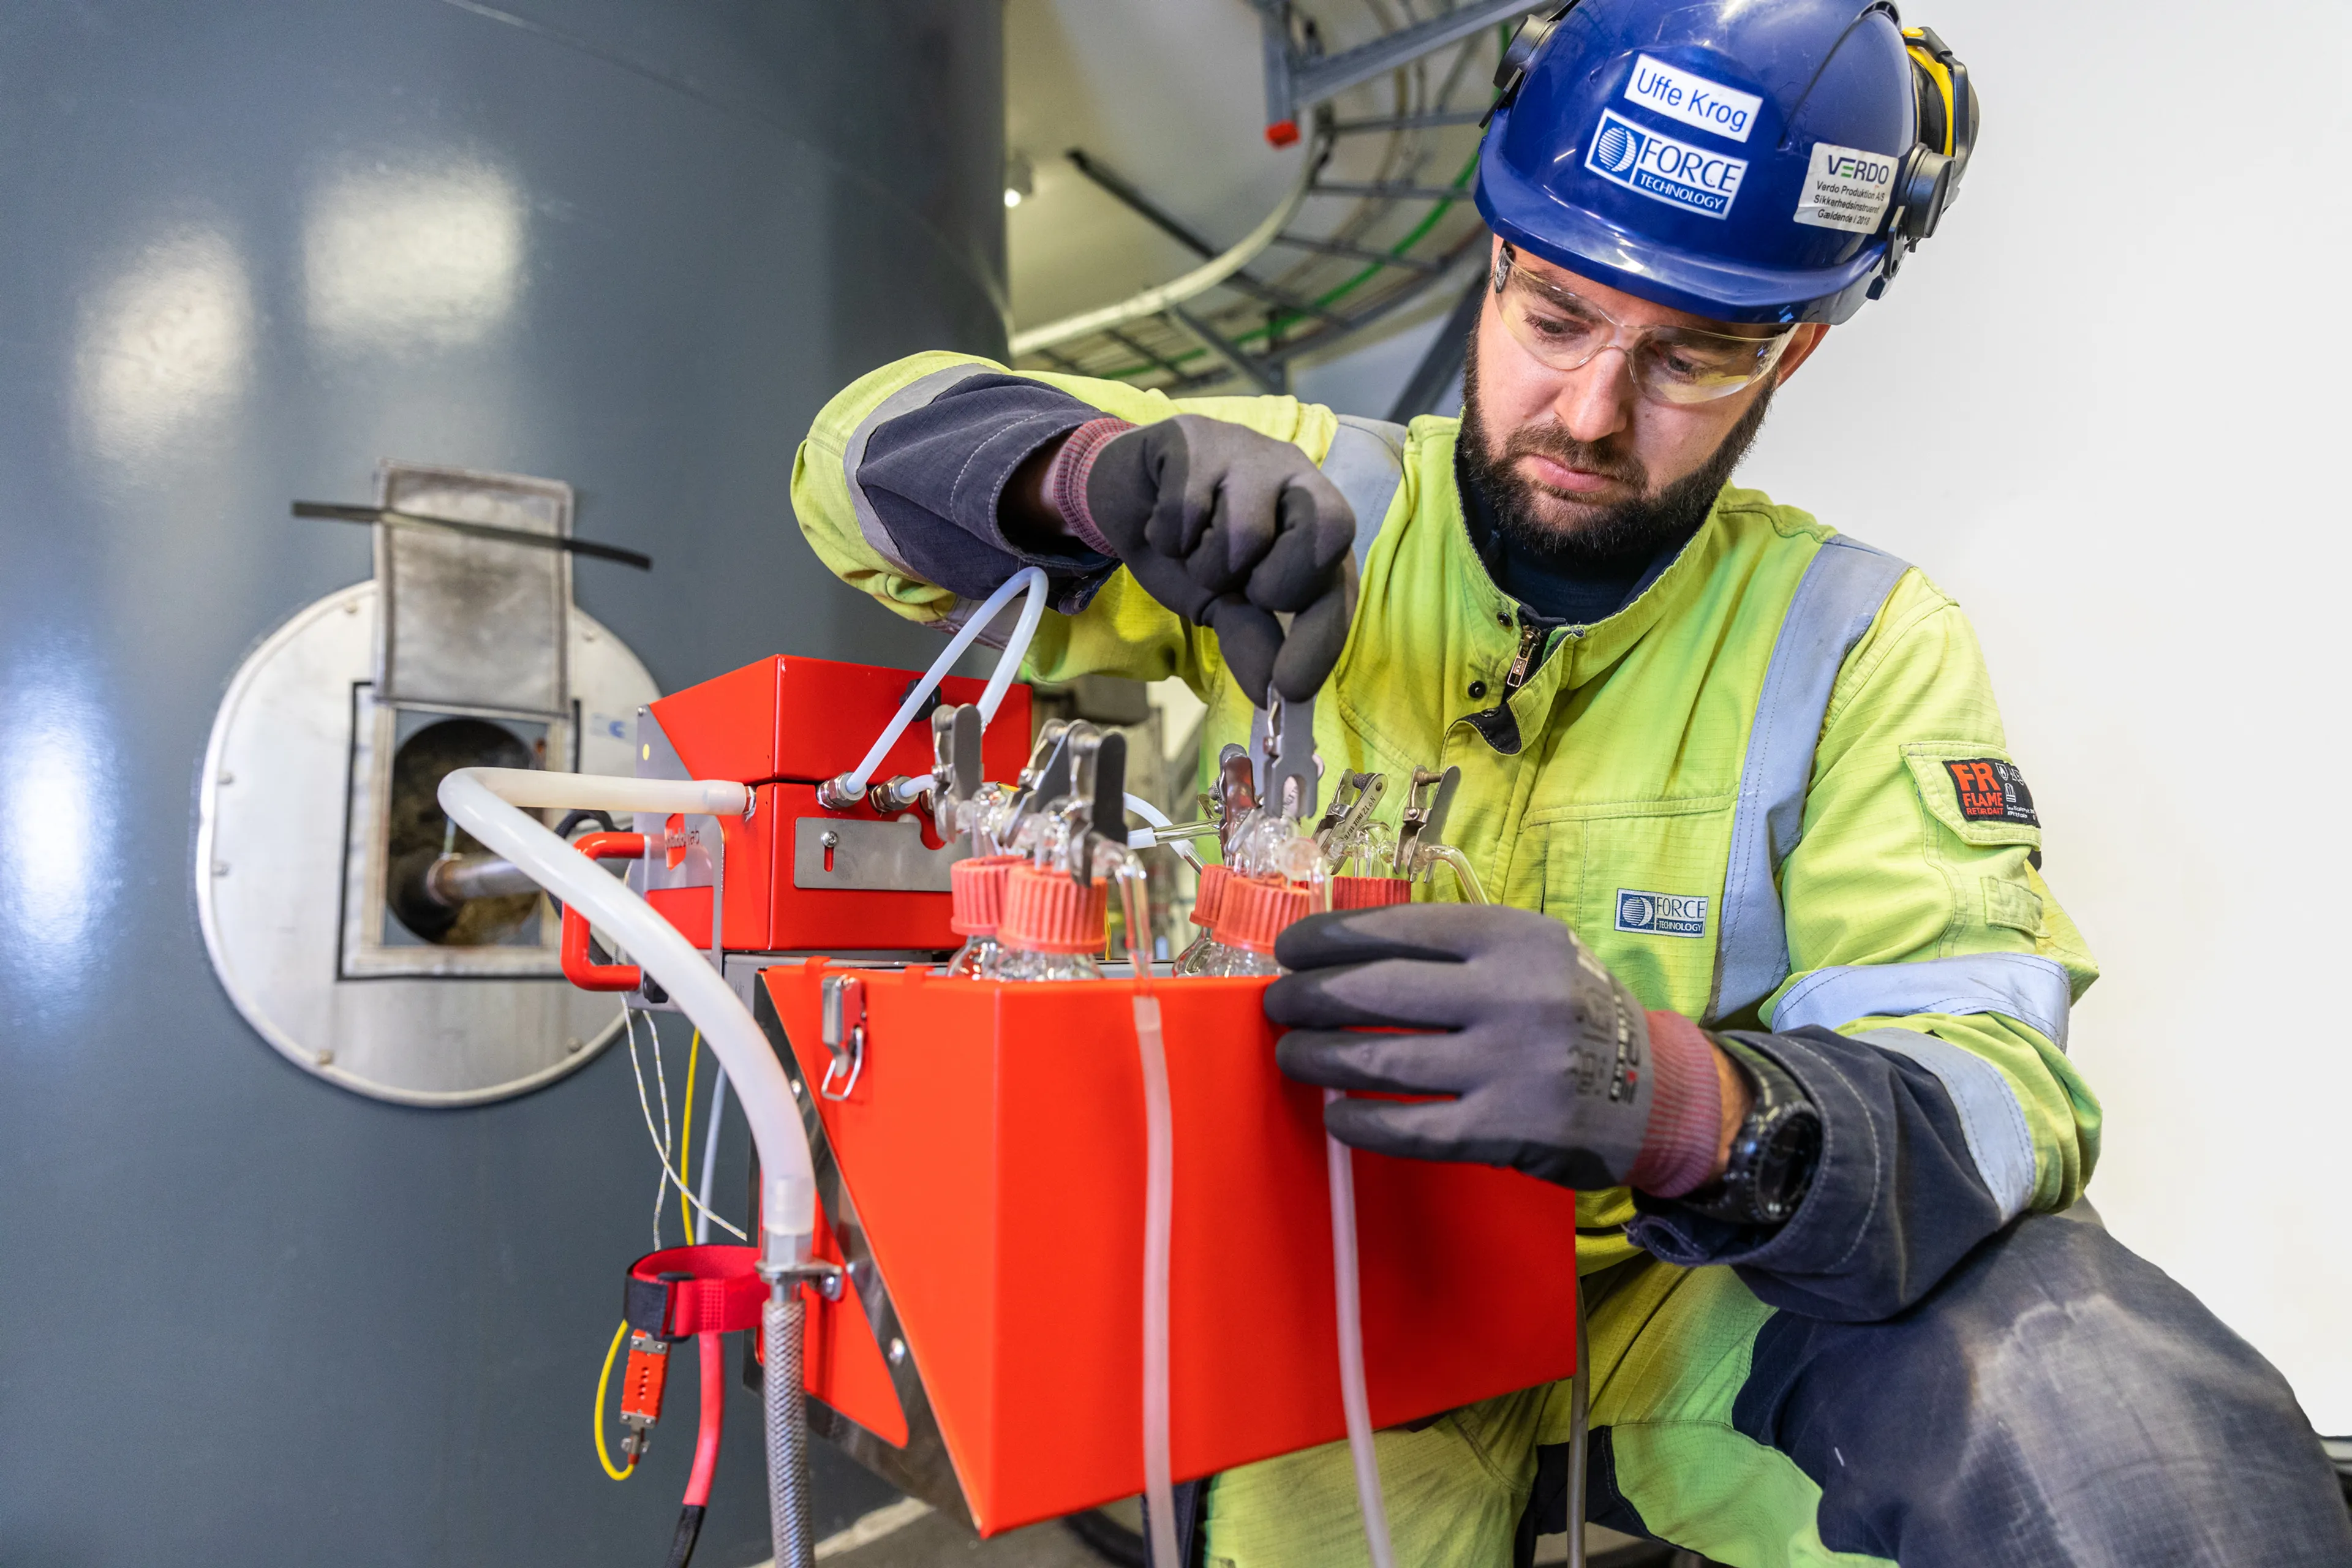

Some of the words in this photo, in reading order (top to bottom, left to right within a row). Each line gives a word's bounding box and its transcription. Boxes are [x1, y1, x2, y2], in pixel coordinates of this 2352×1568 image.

[1637, 68, 1683, 106] Uffe
[1687, 89, 1748, 132] Krog
[1640, 137, 1742, 194] FORCE
[1828, 155, 1890, 185] VERDO
[1640, 173, 1724, 209] TECHNOLOGY
[1817, 181, 1839, 194] Verdo
[1841, 186, 1875, 200] Produktion
[1875, 192, 1885, 202] A/S
[1814, 194, 1880, 214] Sikkerhedsinstrueret
[1818, 209, 1853, 223] Gældende
[1950, 763, 2001, 792] FR
[1962, 792, 2003, 807] FLAME
[1352, 812, 1364, 826] INOX
[1656, 897, 1706, 919] FORCE
[1659, 920, 1702, 932] TECHNOLOGY
